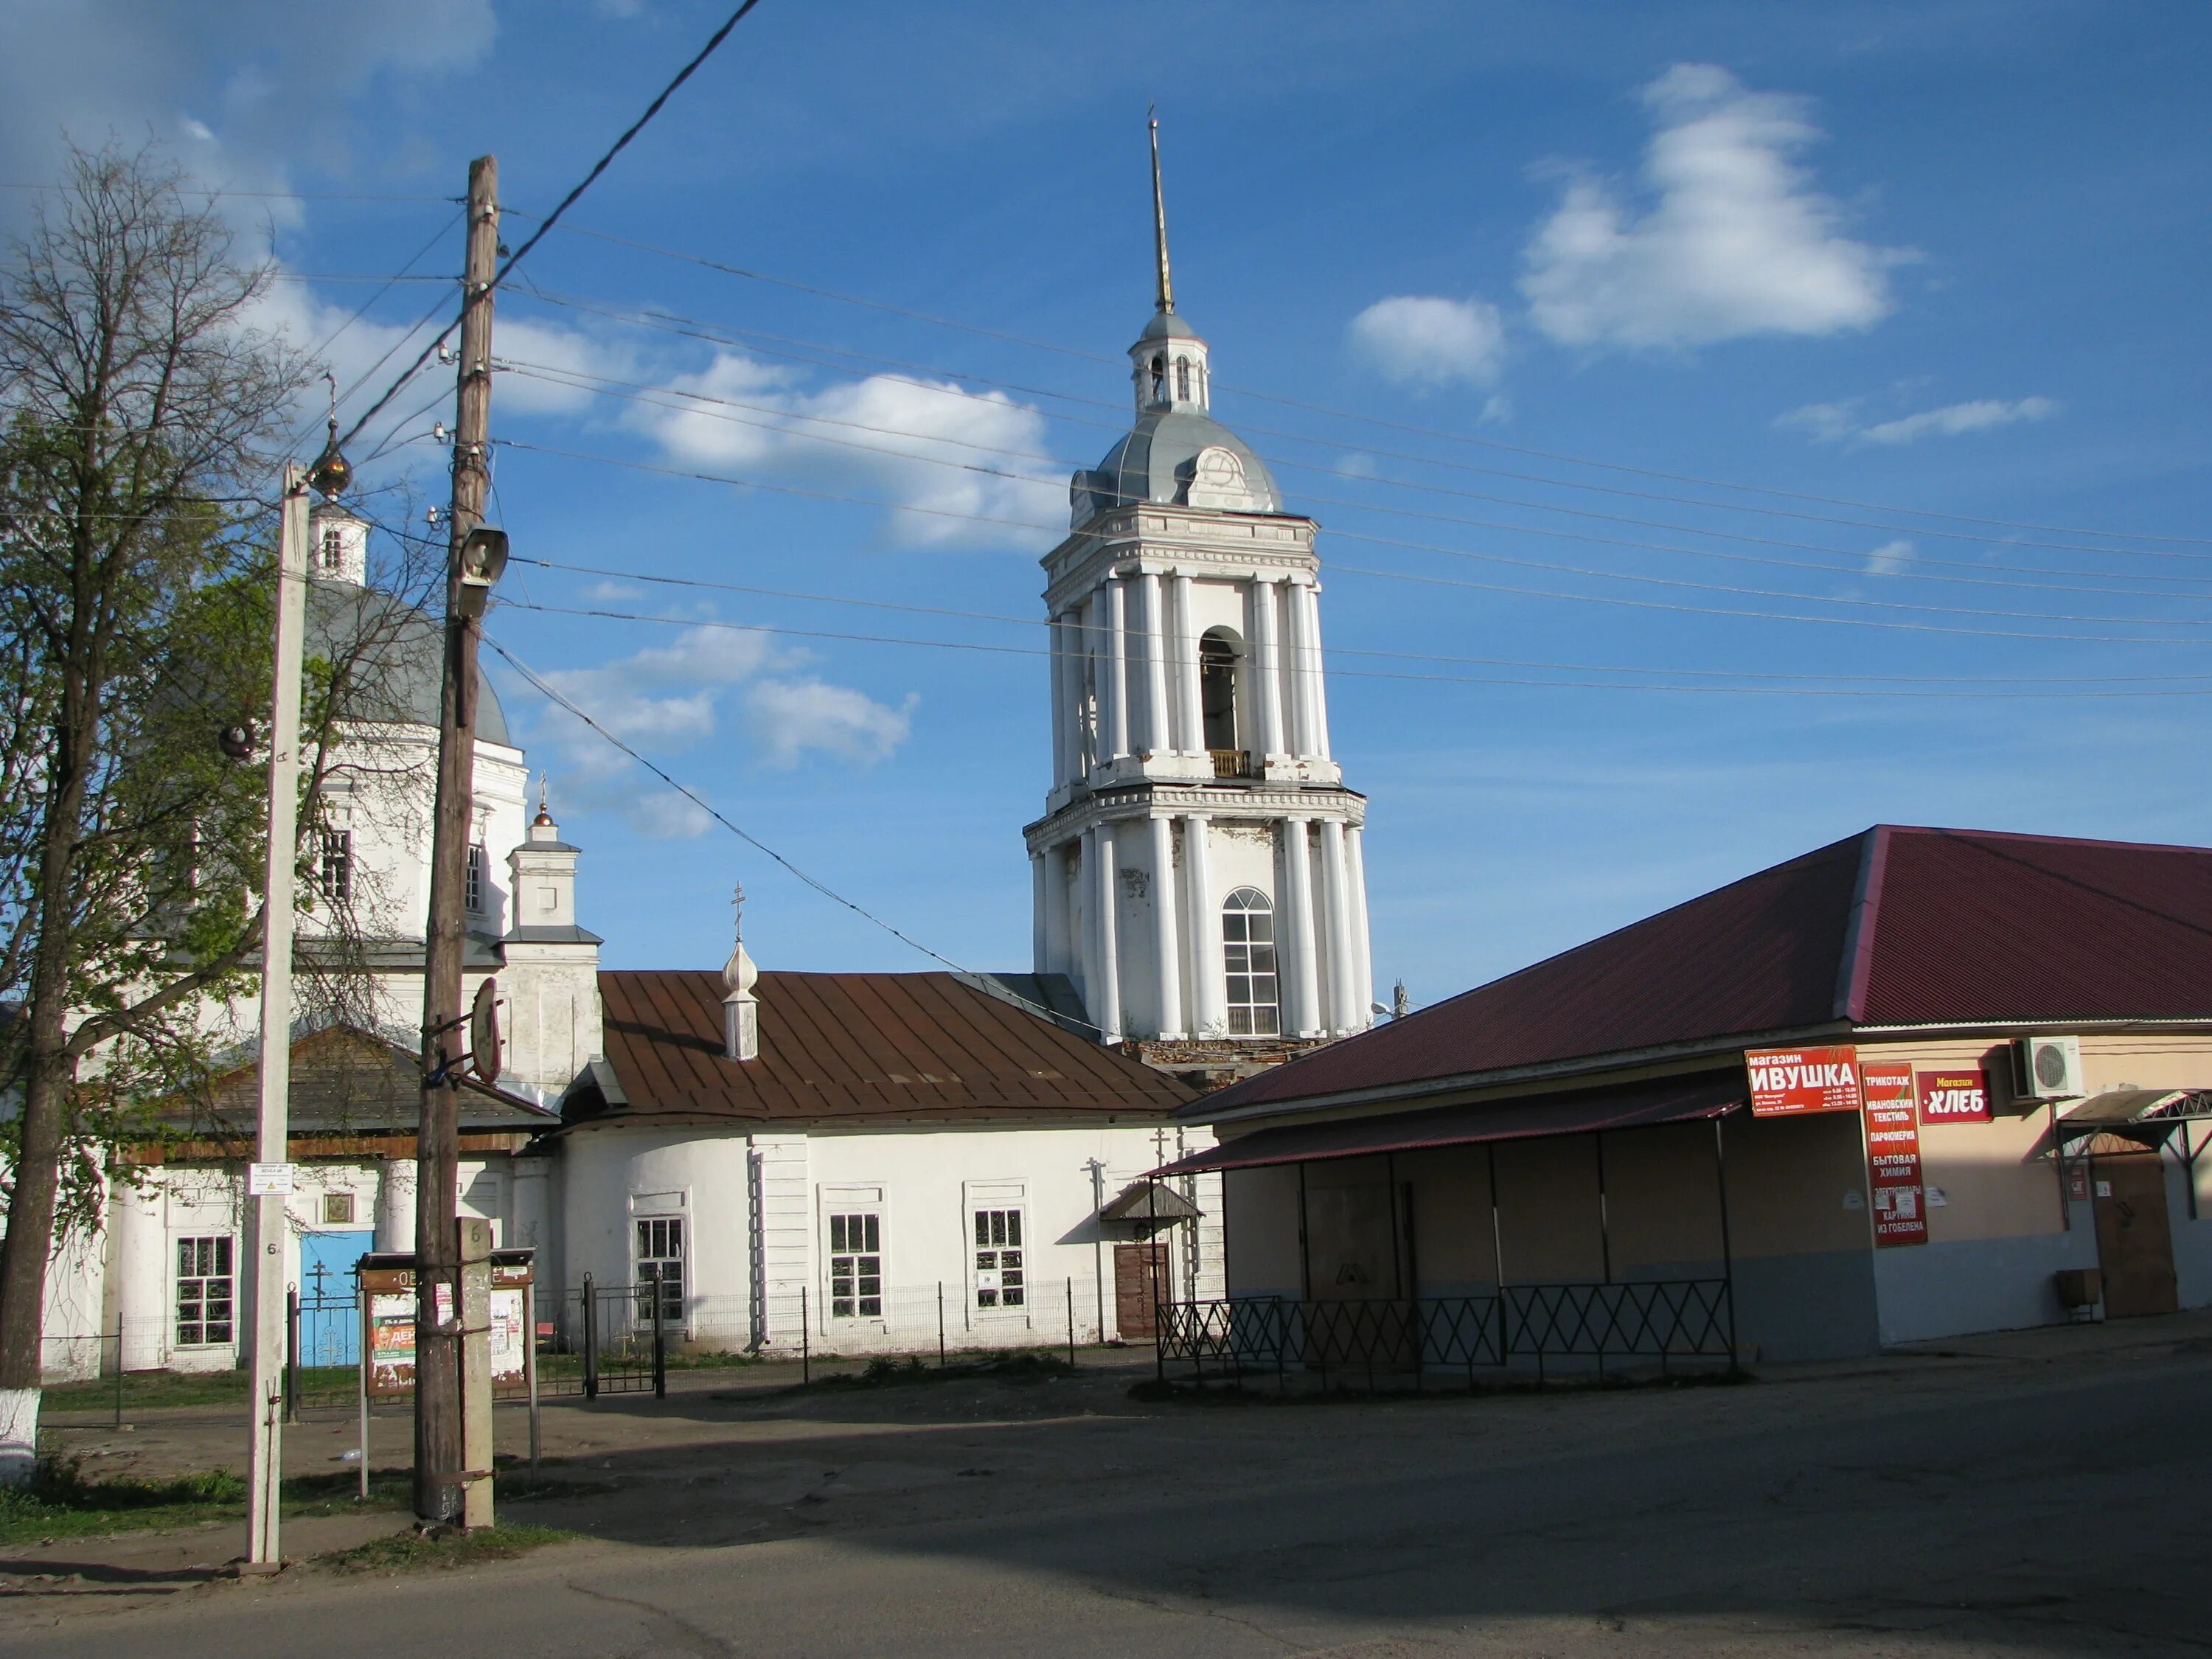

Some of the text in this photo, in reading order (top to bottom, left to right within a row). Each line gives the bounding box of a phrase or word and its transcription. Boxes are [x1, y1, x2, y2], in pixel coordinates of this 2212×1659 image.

[1749, 1054, 1802, 1066] магазин
[1750, 1063, 1855, 1091] ИВУШКА
[1865, 1077, 1910, 1086] ТРИКОТАЖ
[1936, 1077, 1973, 1088] Магазин
[1928, 1089, 1983, 1114] ХЛЕБ
[1874, 1111, 1909, 1122] ТЕКСТИЛЬ
[1871, 1130, 1915, 1142] ПАРФЮМЕРИЯ
[1873, 1154, 1916, 1166] БЫТОВАЯ
[1880, 1166, 1911, 1178] ХИМИЯ
[472, 1225, 481, 1242] 6
[1877, 1221, 1924, 1234] ИЗ ГОБЕЛЕНА
[392, 1330, 416, 1343] ДЕН
